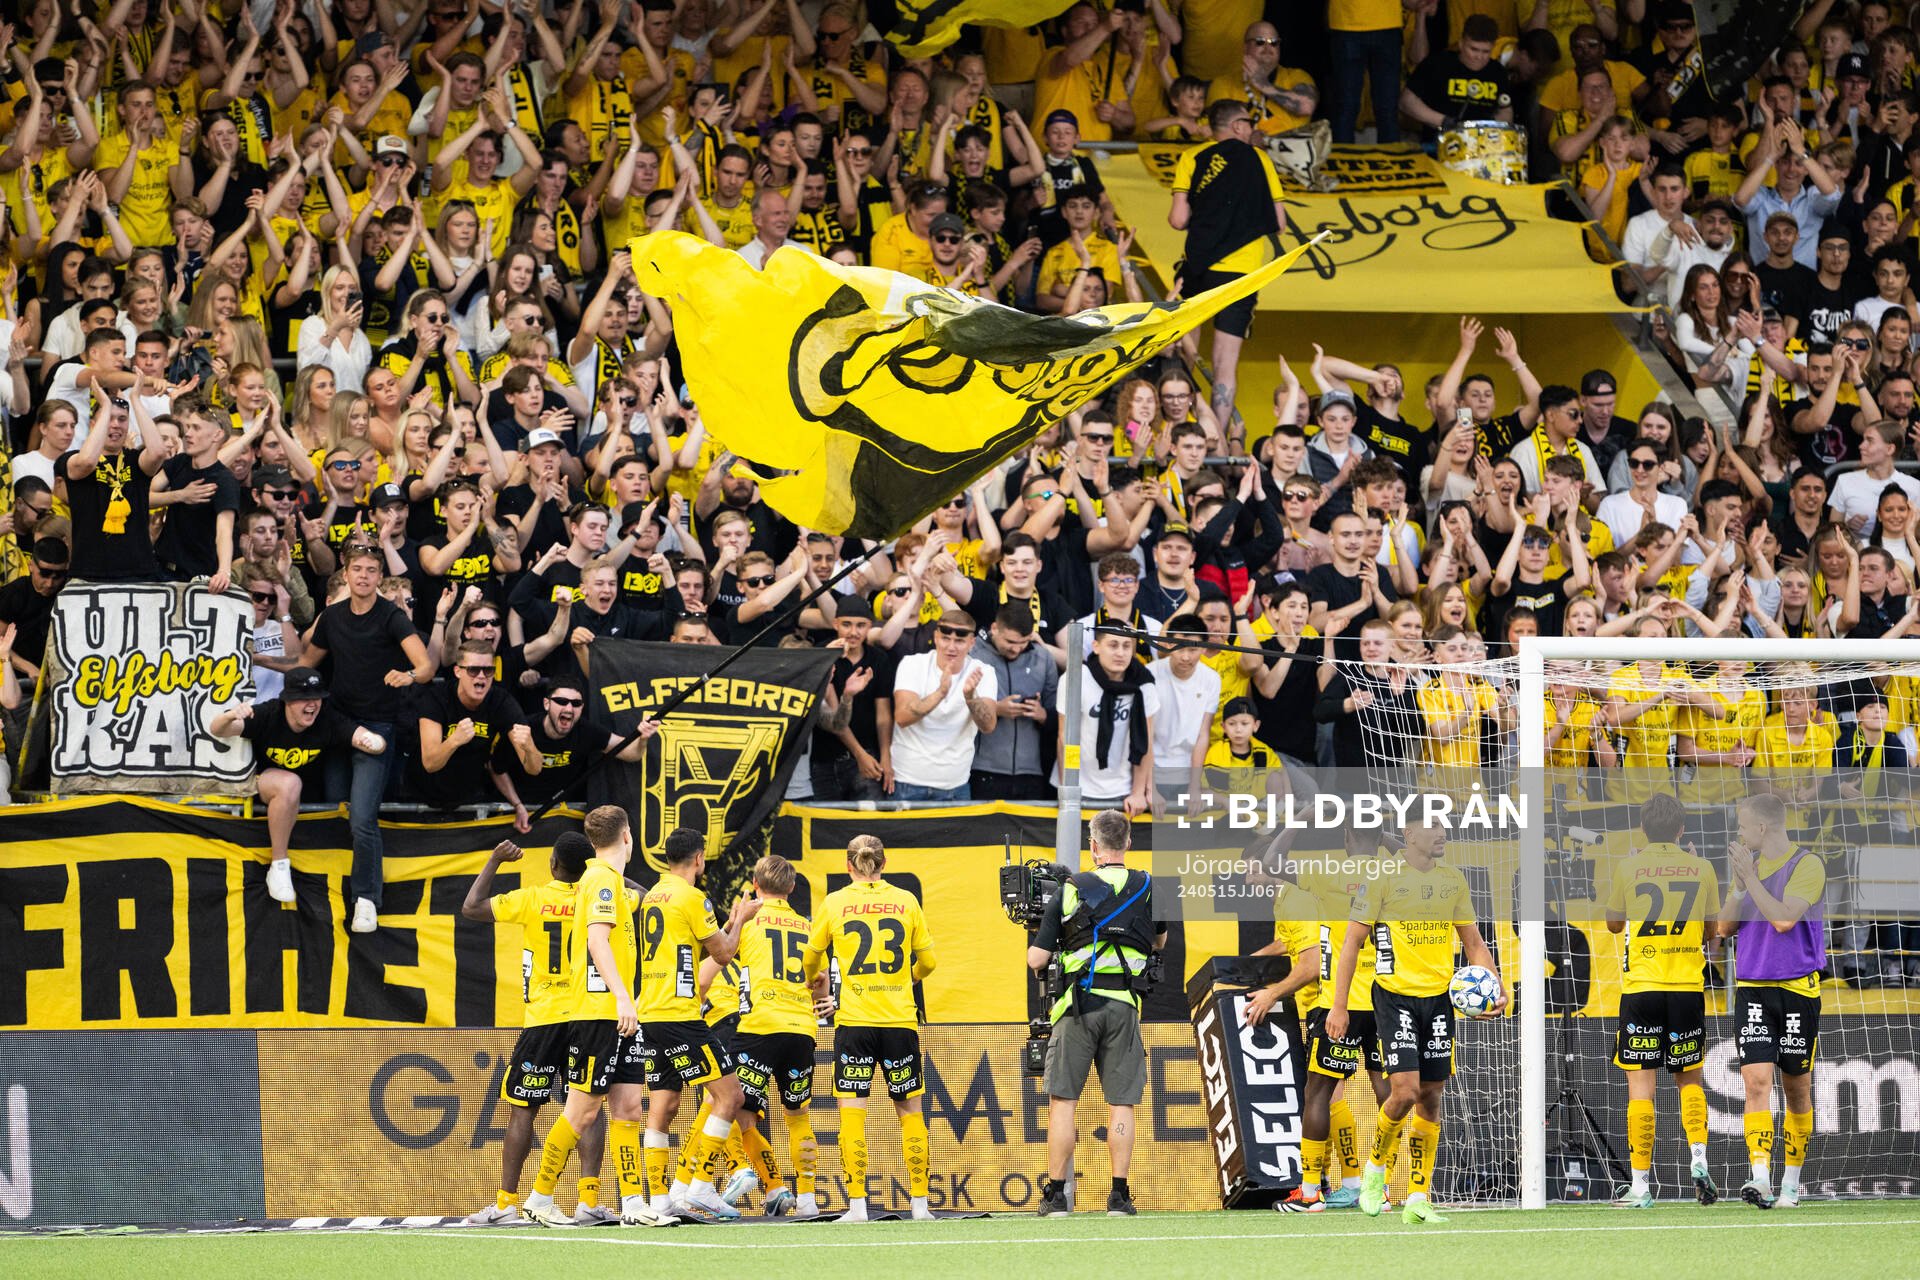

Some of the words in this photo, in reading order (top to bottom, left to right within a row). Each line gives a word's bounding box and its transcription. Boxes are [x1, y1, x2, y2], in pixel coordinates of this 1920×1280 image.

[74, 649, 244, 717] Elfsborg
[600, 676, 816, 718] ELFSBORG!
[1635, 866, 1699, 880] PULSEN
[842, 903, 905, 917] PULSEN
[1635, 881, 1700, 938] 27
[756, 916, 812, 931] PULSEN
[543, 921, 573, 975] 1
[843, 917, 905, 976] 23
[765, 928, 809, 984] 15
[1741, 1023, 1768, 1036] ellos
[1427, 1036, 1452, 1050] ellos
[1632, 1038, 1658, 1048] EAB
[1780, 1033, 1806, 1046] ellos
[1624, 1049, 1660, 1060] Cernera
[1673, 1041, 1695, 1055] EAB
[738, 1068, 764, 1086] EAB
[846, 1067, 871, 1078] EAB
[891, 1067, 910, 1082] EAB
[525, 1075, 546, 1087] EAB
[1234, 994, 1304, 1183] SELECT
